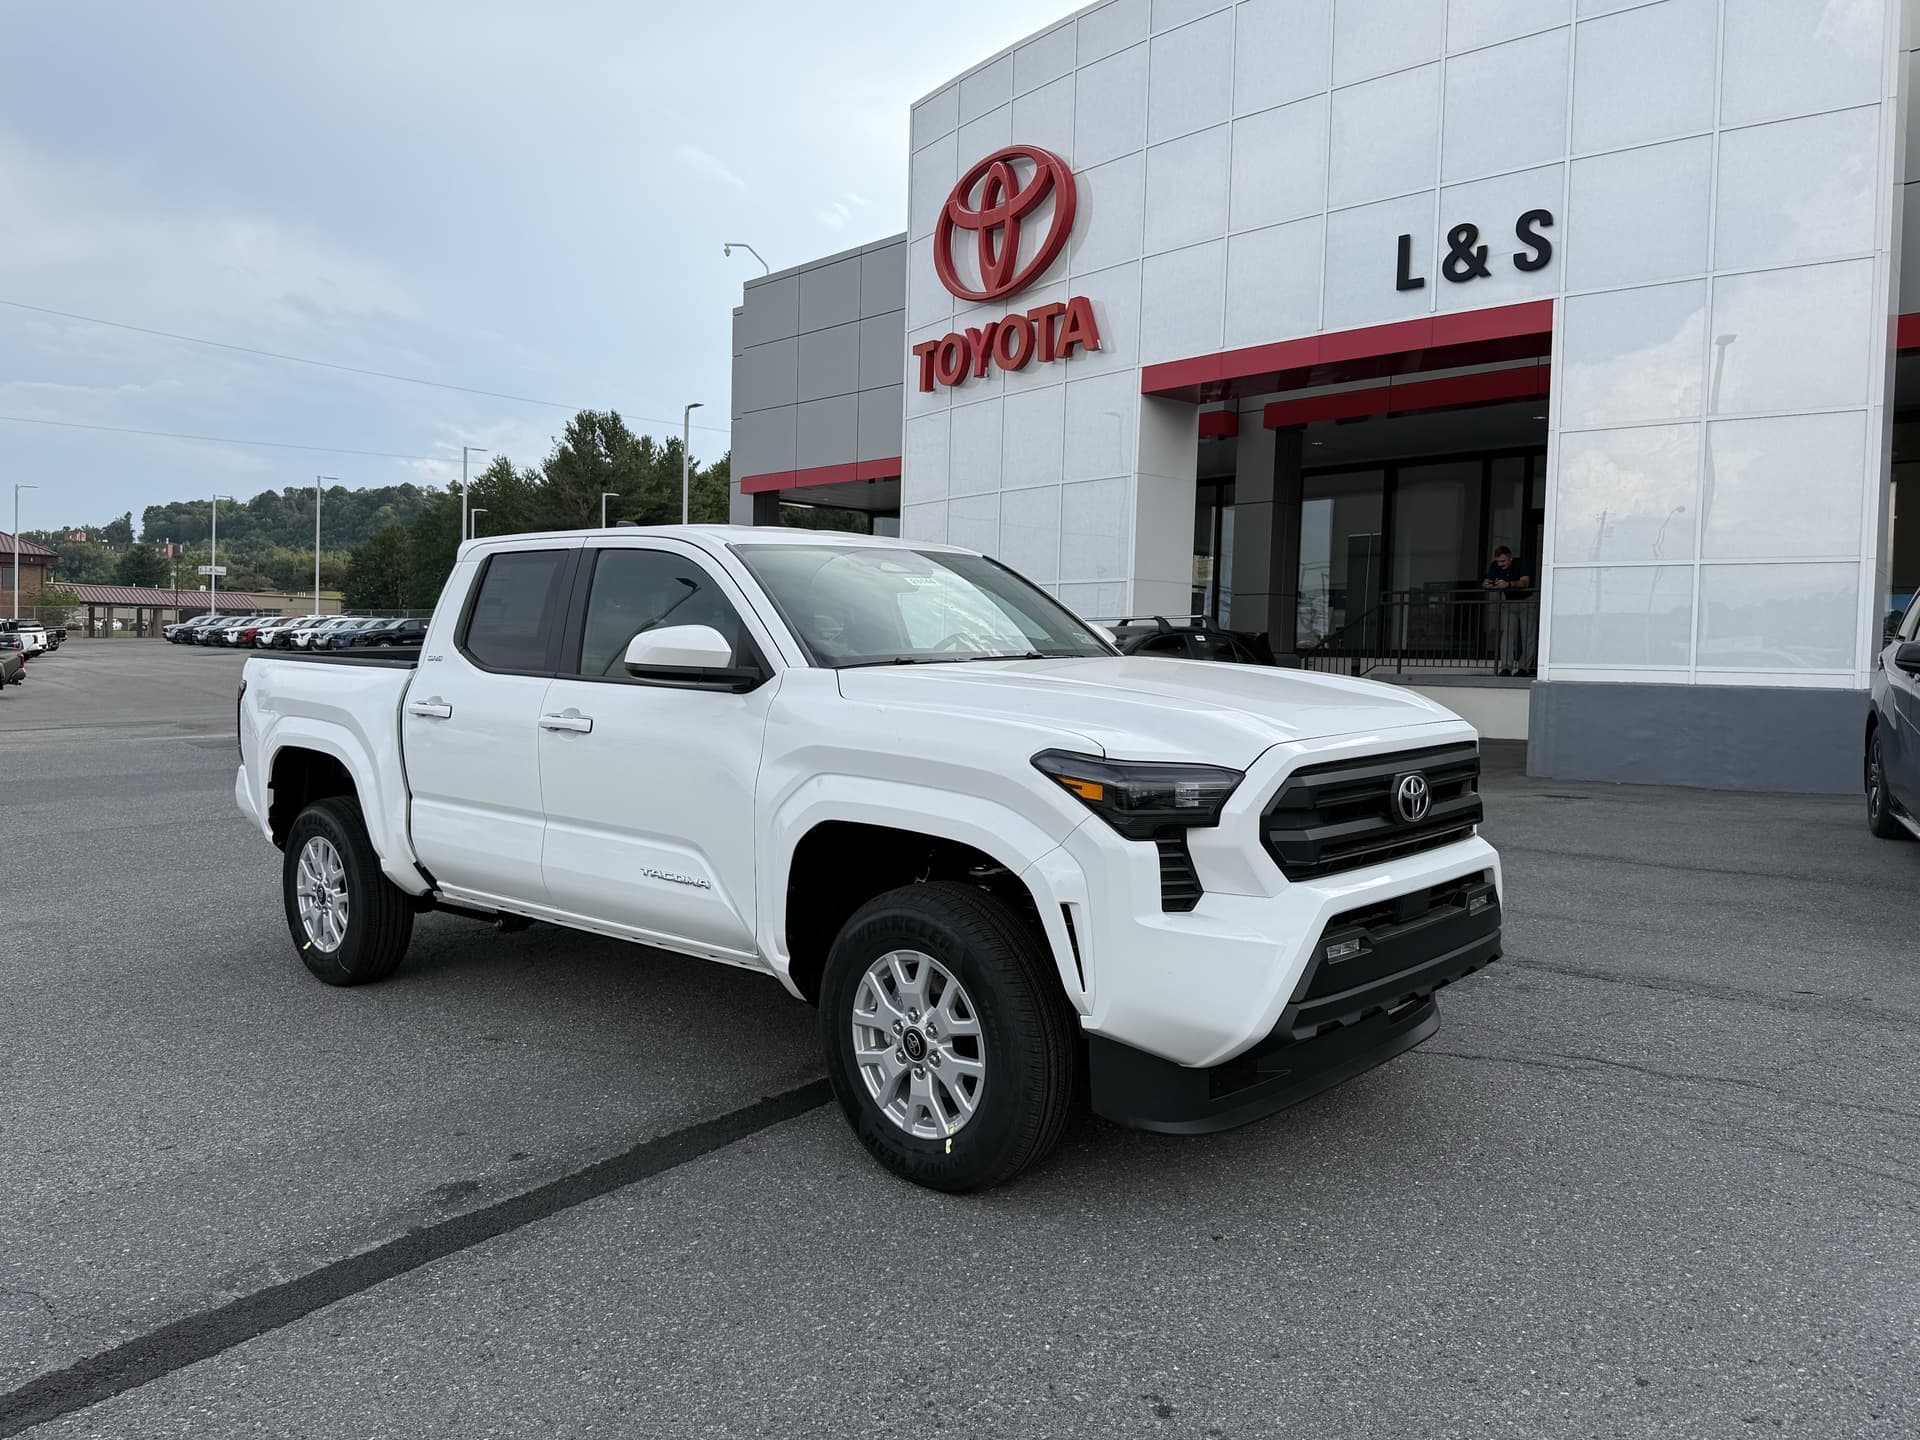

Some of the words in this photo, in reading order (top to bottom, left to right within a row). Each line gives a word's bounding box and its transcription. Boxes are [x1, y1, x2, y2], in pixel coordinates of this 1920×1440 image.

[1396, 234, 1425, 291] L
[1442, 223, 1492, 283] &
[1513, 209, 1554, 272] S
[912, 296, 1101, 392] TOYOTA
[640, 867, 711, 890] TACOMA
